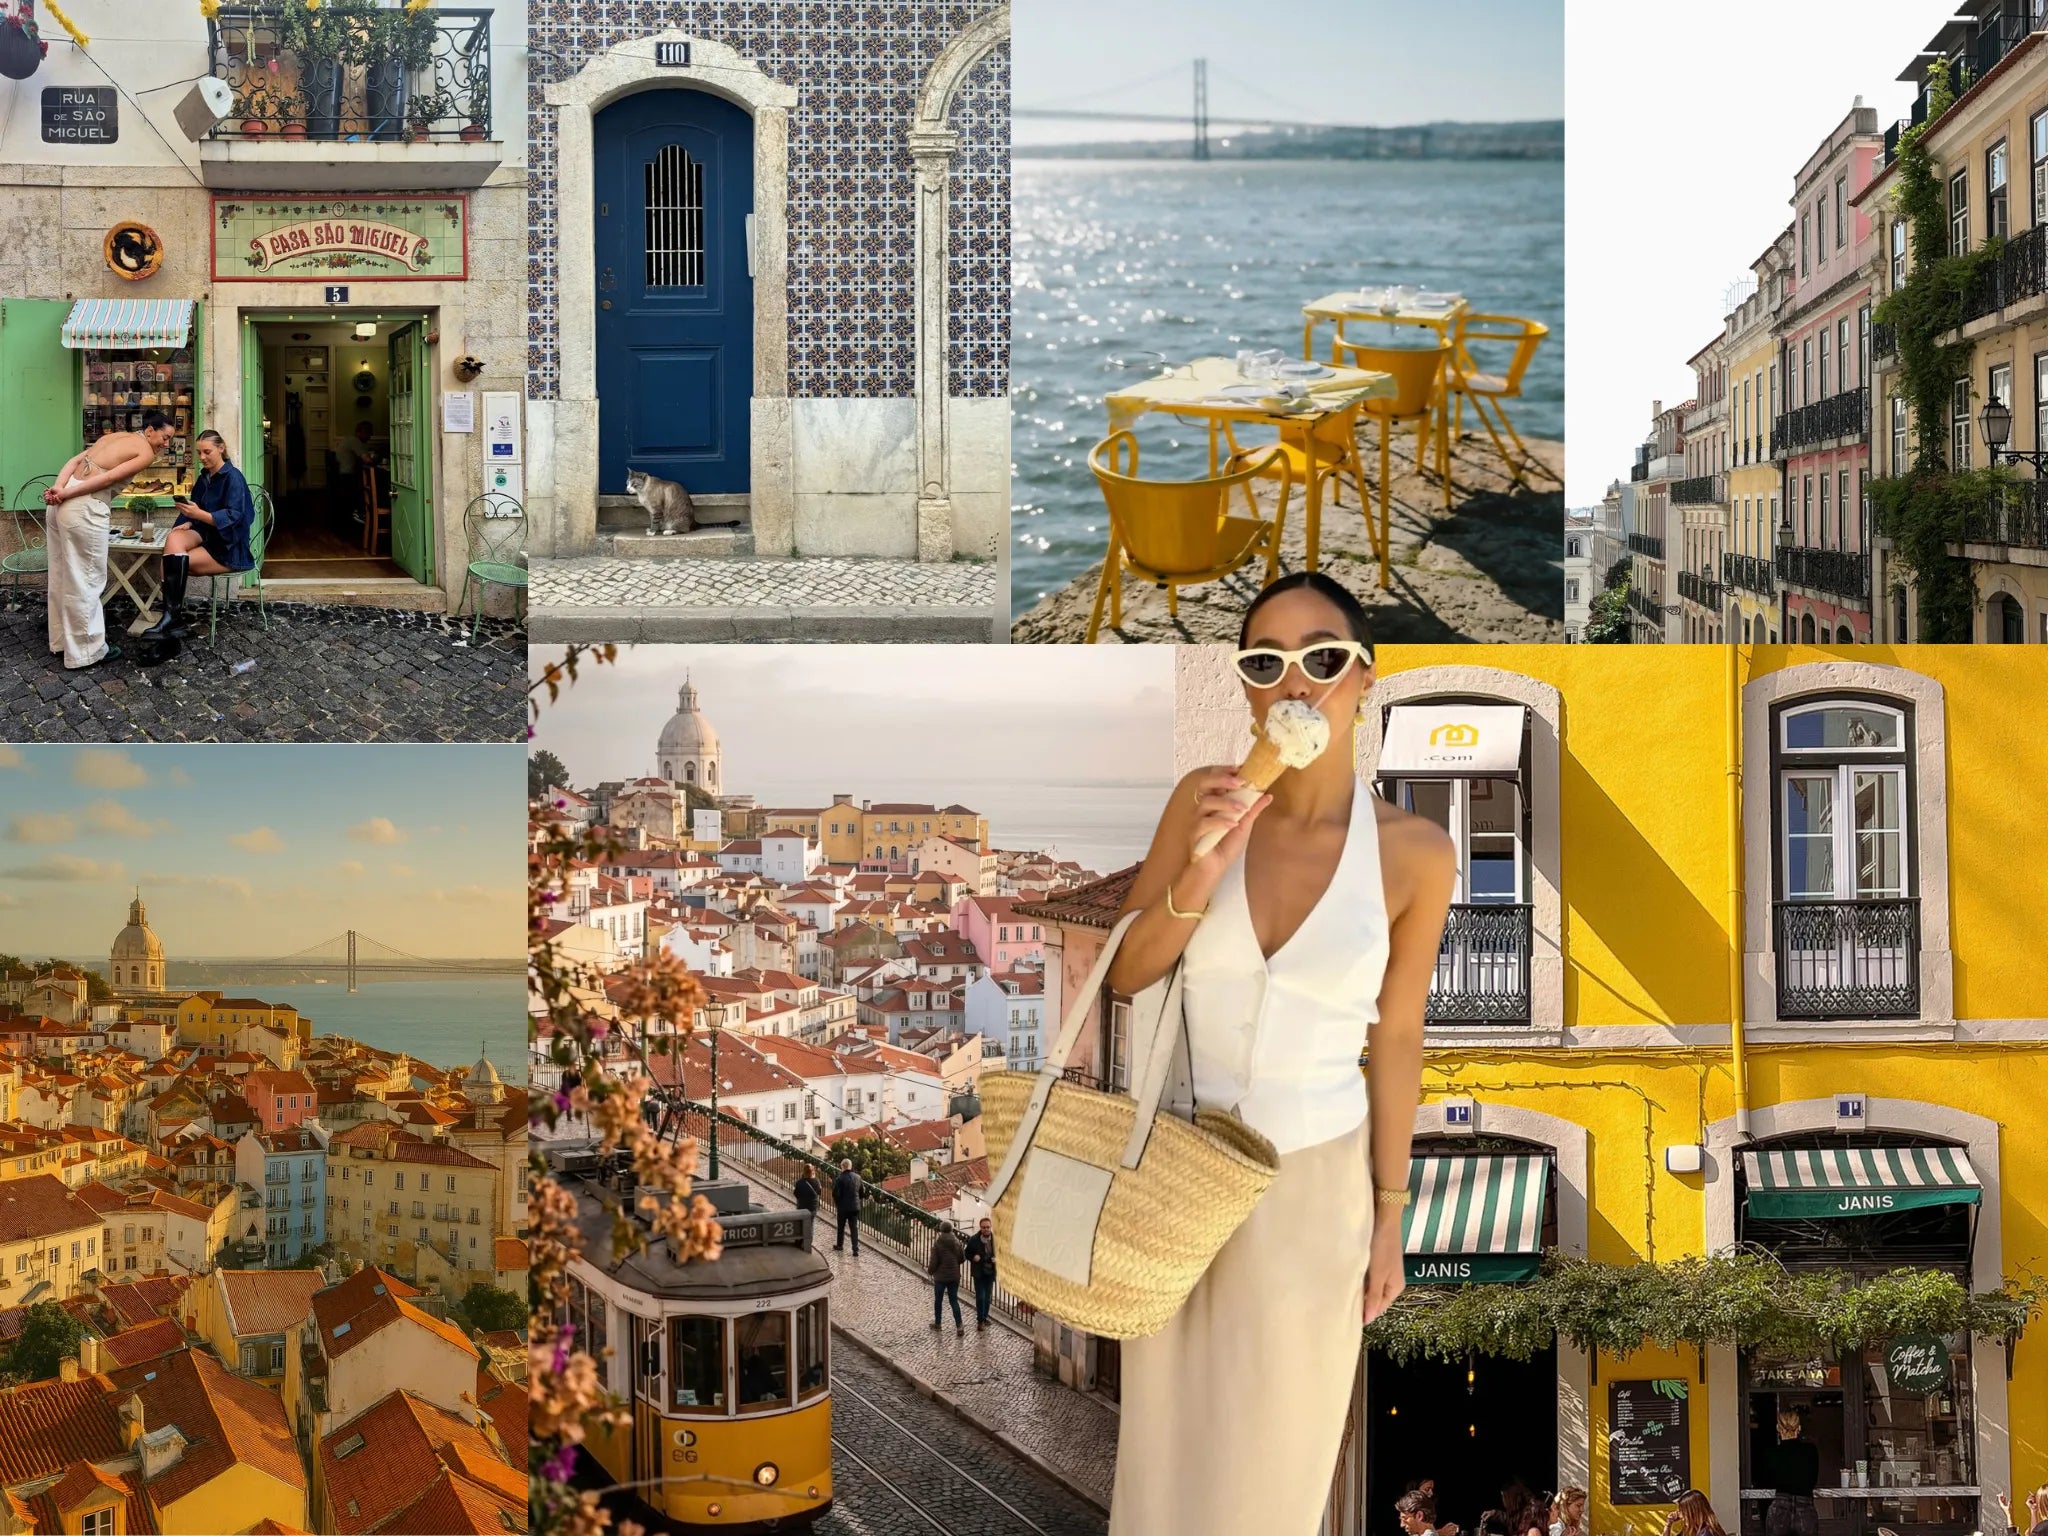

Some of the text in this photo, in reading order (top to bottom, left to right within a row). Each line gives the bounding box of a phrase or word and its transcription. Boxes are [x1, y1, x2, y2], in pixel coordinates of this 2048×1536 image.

[660, 43, 685, 64] 110
[62, 93, 96, 104] RUA
[53, 108, 106, 121] DE SÃO
[48, 127, 111, 138] MIGUEL
[269, 222, 409, 257] CASA SÃO MIGUEL
[332, 287, 341, 302] 5
[1838, 1195, 1894, 1211] JANIS
[723, 1222, 794, 1240] TRICO 28
[1414, 1262, 1471, 1278] JANIS
[1890, 1345, 1937, 1364] Coffee &
[1760, 1369, 1793, 1380] TAKE
[1892, 1357, 1942, 1380] Matcha
